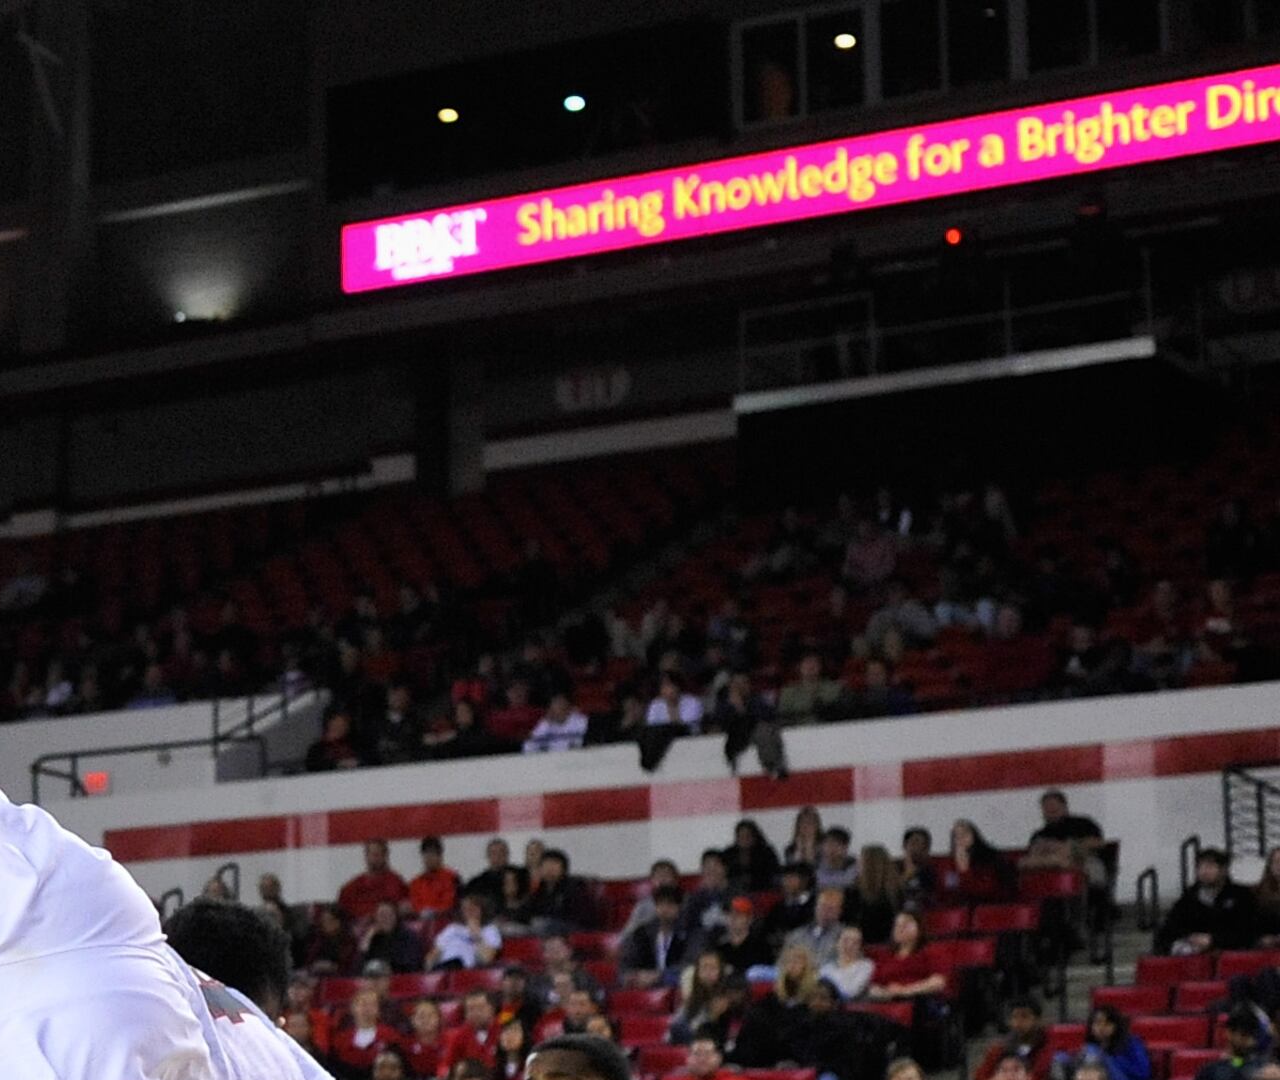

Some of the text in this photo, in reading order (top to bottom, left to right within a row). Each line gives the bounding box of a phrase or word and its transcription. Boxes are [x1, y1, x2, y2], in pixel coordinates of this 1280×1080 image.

[518, 188, 663, 246] Sharing
[673, 146, 897, 220] Knowledge
[907, 134, 970, 181] for
[978, 134, 1005, 168] a
[1017, 101, 1196, 164] Brighter
[1206, 79, 1280, 130] Dir
